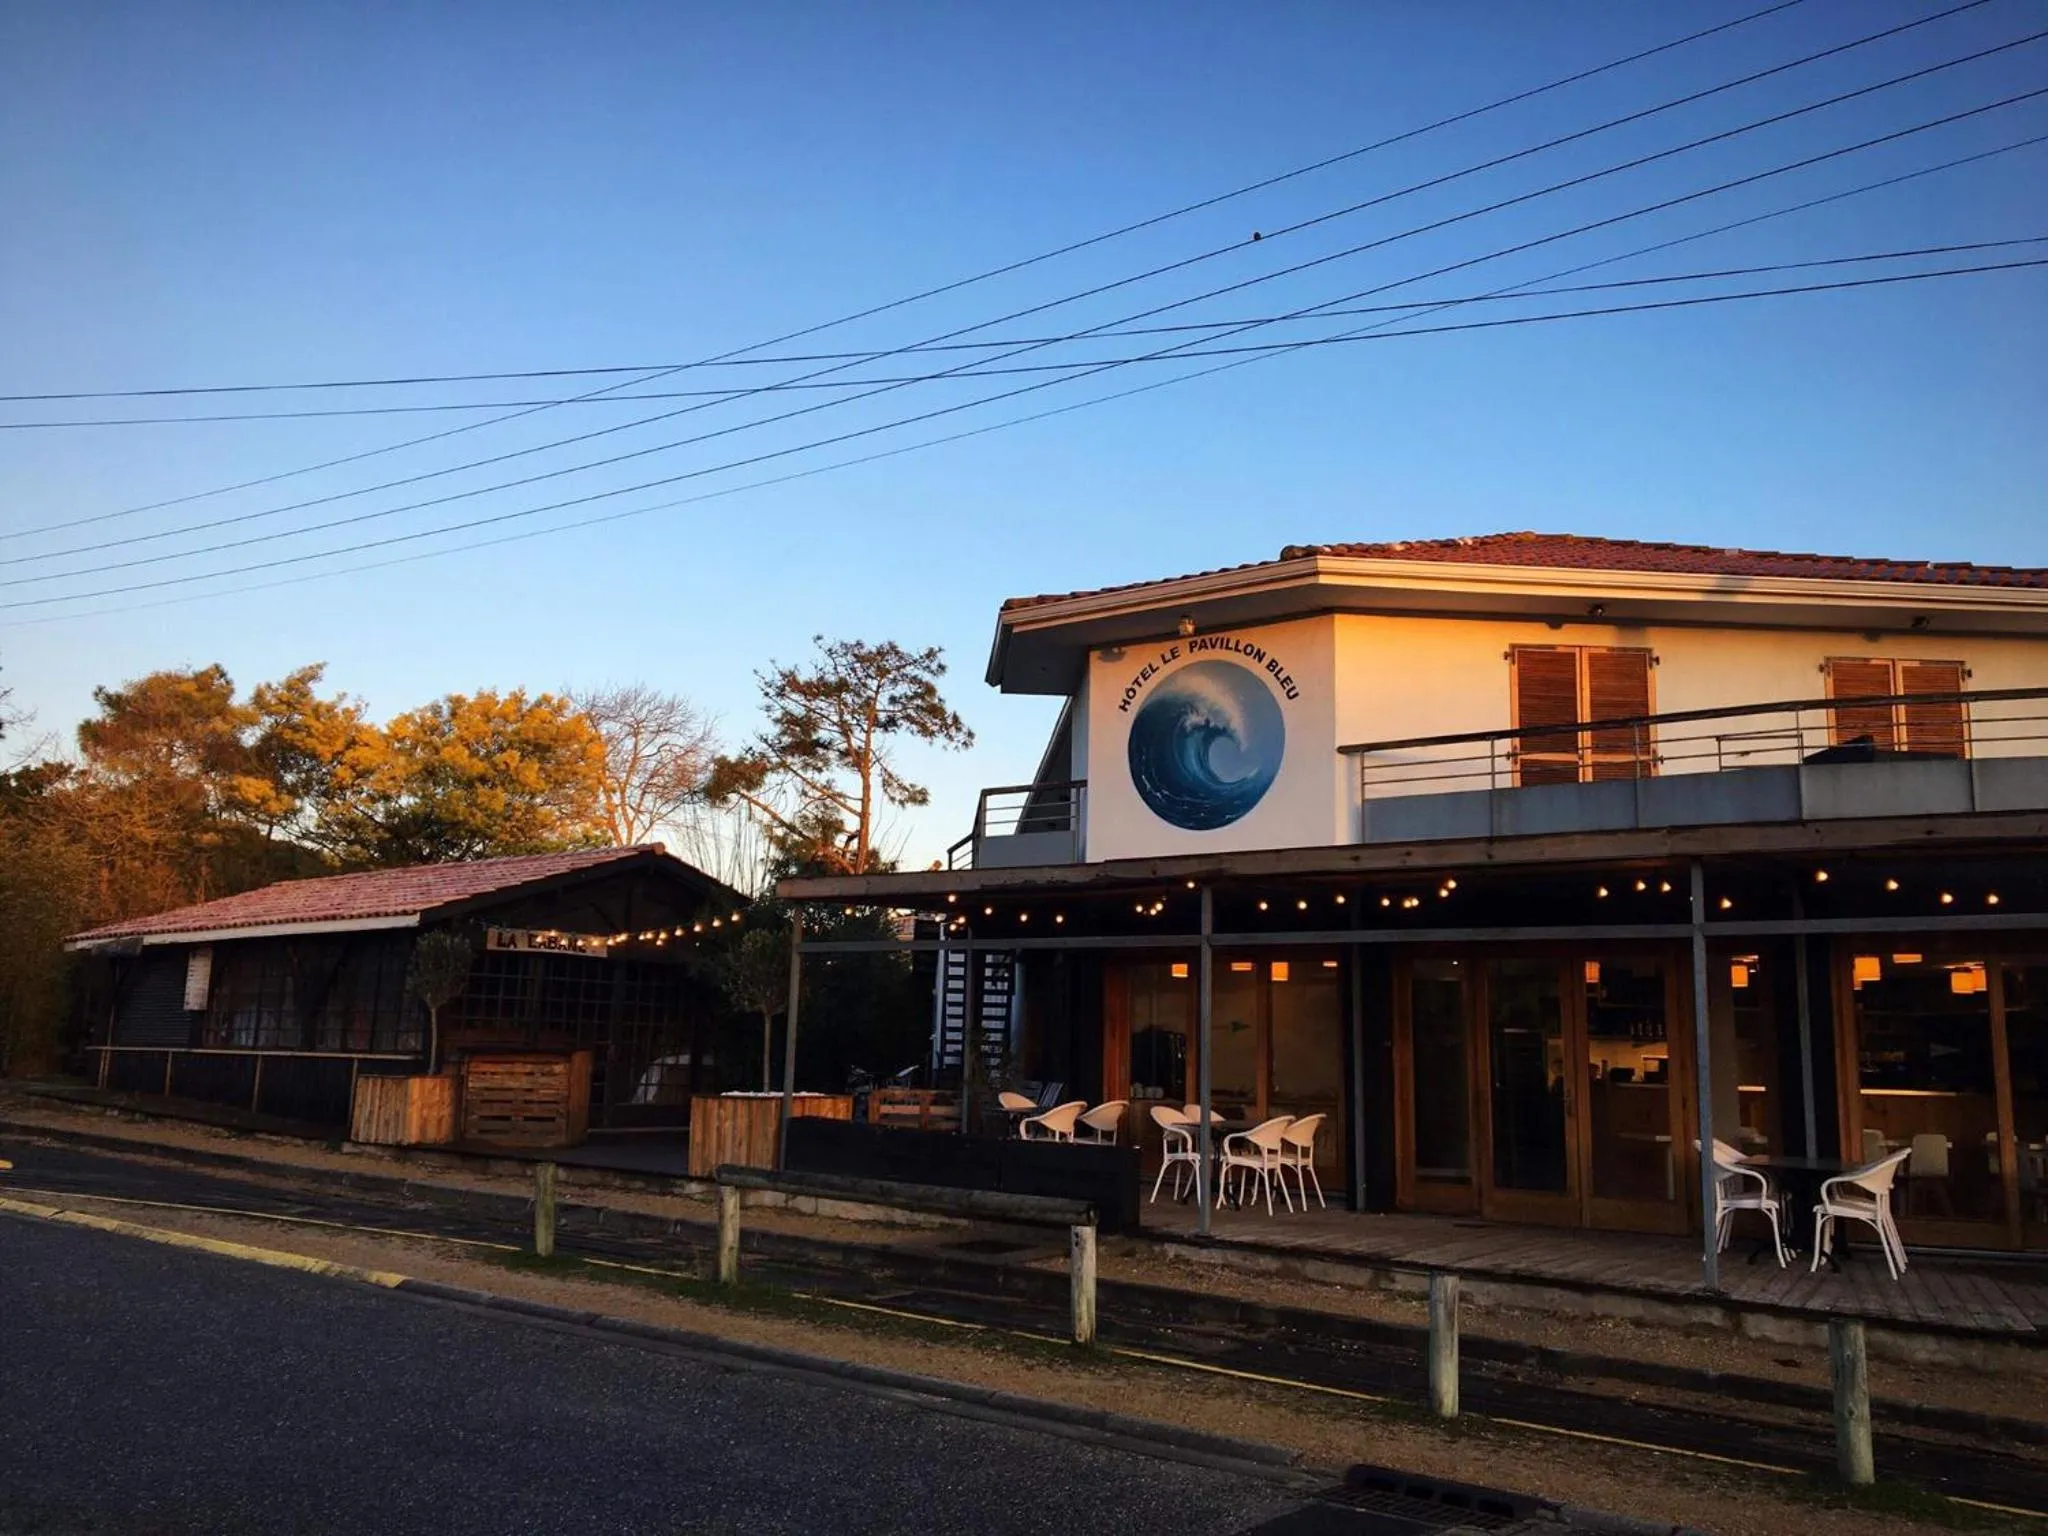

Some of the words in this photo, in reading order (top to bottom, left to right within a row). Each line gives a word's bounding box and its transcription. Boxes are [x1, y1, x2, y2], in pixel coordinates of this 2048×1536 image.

[1160, 646, 1181, 665] LE
[1188, 636, 1266, 664] PAVILLON
[1265, 658, 1299, 701] BLEU
[497, 931, 518, 949] LA
